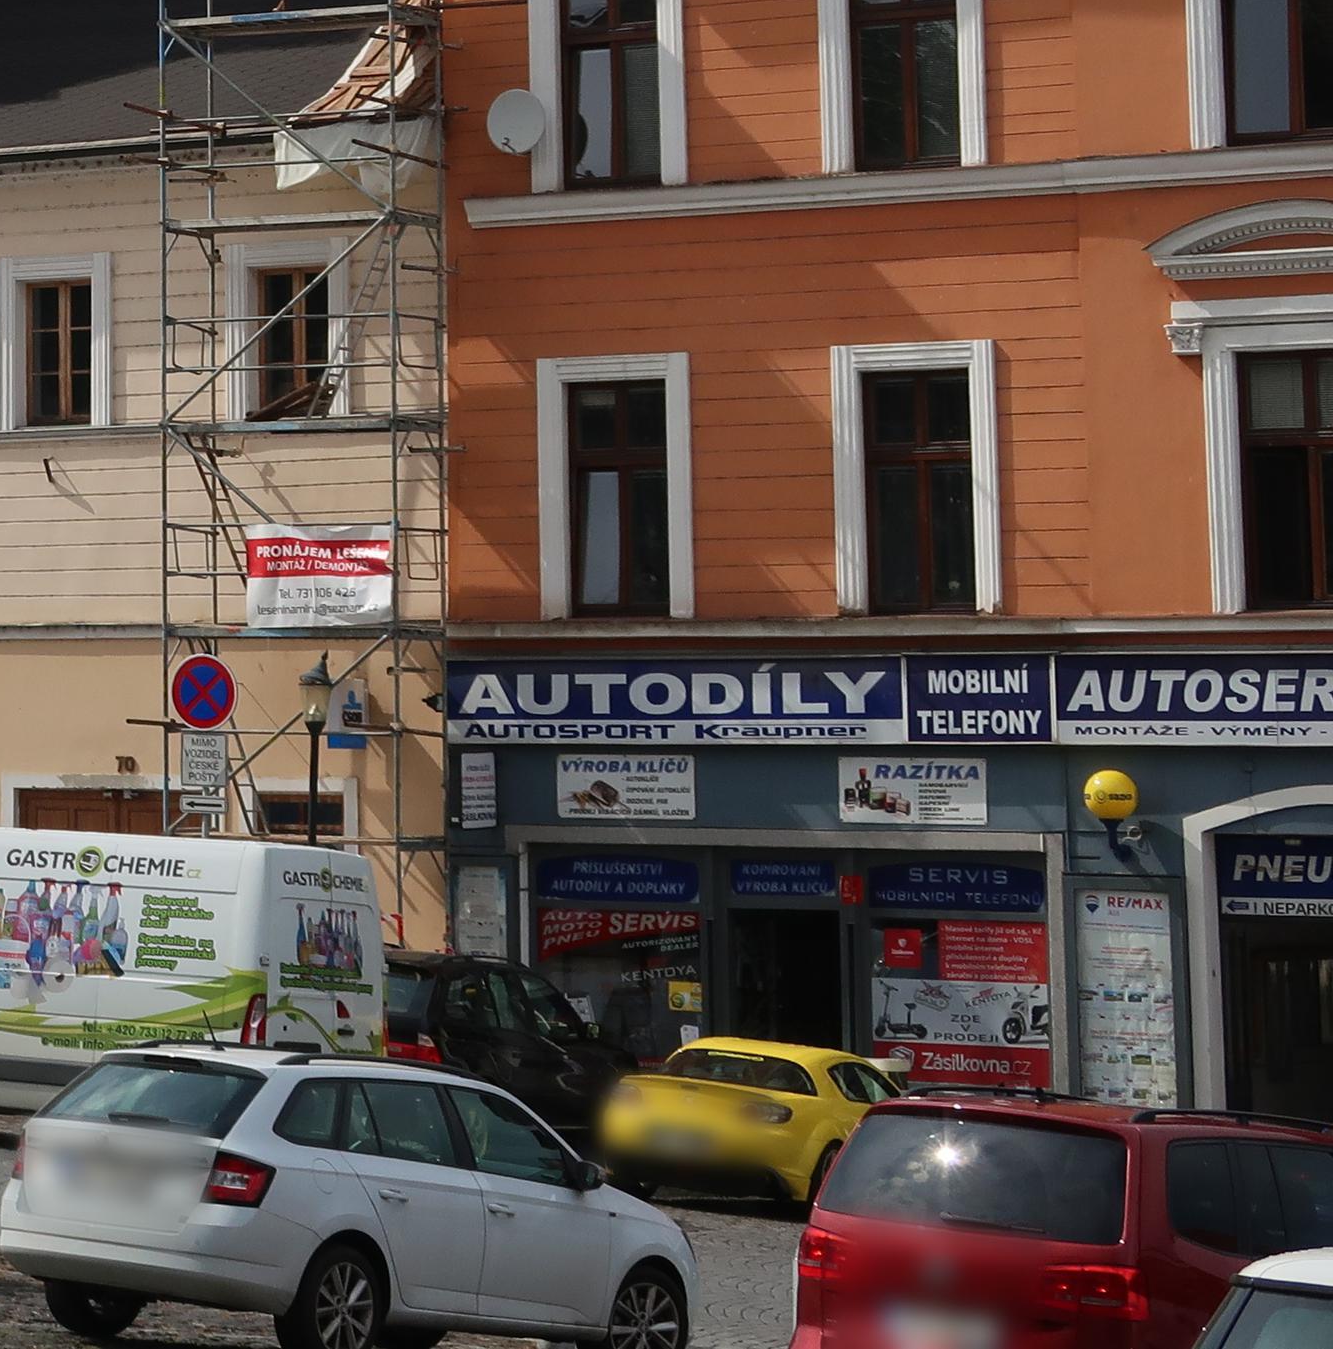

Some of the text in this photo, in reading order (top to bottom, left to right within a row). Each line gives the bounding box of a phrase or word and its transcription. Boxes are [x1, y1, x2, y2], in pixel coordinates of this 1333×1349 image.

[256, 541, 332, 559] PRONÁJEM
[267, 558, 306, 571] MONTÁŽ
[297, 588, 313, 599] 731
[927, 662, 1029, 695] MOBILNÍ
[459, 662, 886, 715] AUTODÍLY
[1066, 669, 1333, 713] AUTOSER
[916, 709, 1042, 735] TELEFONY
[464, 723, 868, 741] AUTOSPORT Kraupner
[1074, 725, 1189, 736] MONTÁŽE
[1210, 725, 1312, 736] VÝMĚNY
[191, 737, 217, 748] MIMO
[184, 748, 223, 760] VOZIDEL
[561, 757, 689, 773] VÝROBA KLÍČŮ
[874, 762, 980, 780] RAZÍTKA
[188, 771, 220, 782] POŠTY
[909, 867, 1009, 885] SERVIS
[1233, 854, 1333, 883] PNEU
[614, 881, 624, 893] A
[143, 893, 199, 907] Dodavatel
[1107, 896, 1163, 911] RE/MAX
[141, 907, 214, 921] drogistického
[542, 910, 602, 921] AUTO
[542, 921, 602, 935] MOTO
[608, 912, 697, 935] SERVIS
[137, 933, 213, 949] Specialista na
[542, 929, 601, 950] PNEU
[660, 942, 700, 952] DEALER
[136, 946, 216, 961] gastronomické
[134, 958, 179, 972] provozy
[620, 964, 697, 983] KENTOYA
[950, 1013, 981, 1023] ZDE
[107, 1024, 136, 1036] +420
[139, 1026, 158, 1038] 733
[161, 1028, 172, 1039] 12
[960, 1024, 971, 1032] V
[41, 1036, 80, 1049] e-mail:
[934, 1032, 999, 1043] PRODEJI
[921, 1051, 1032, 1076] Zásilkovna.cz
